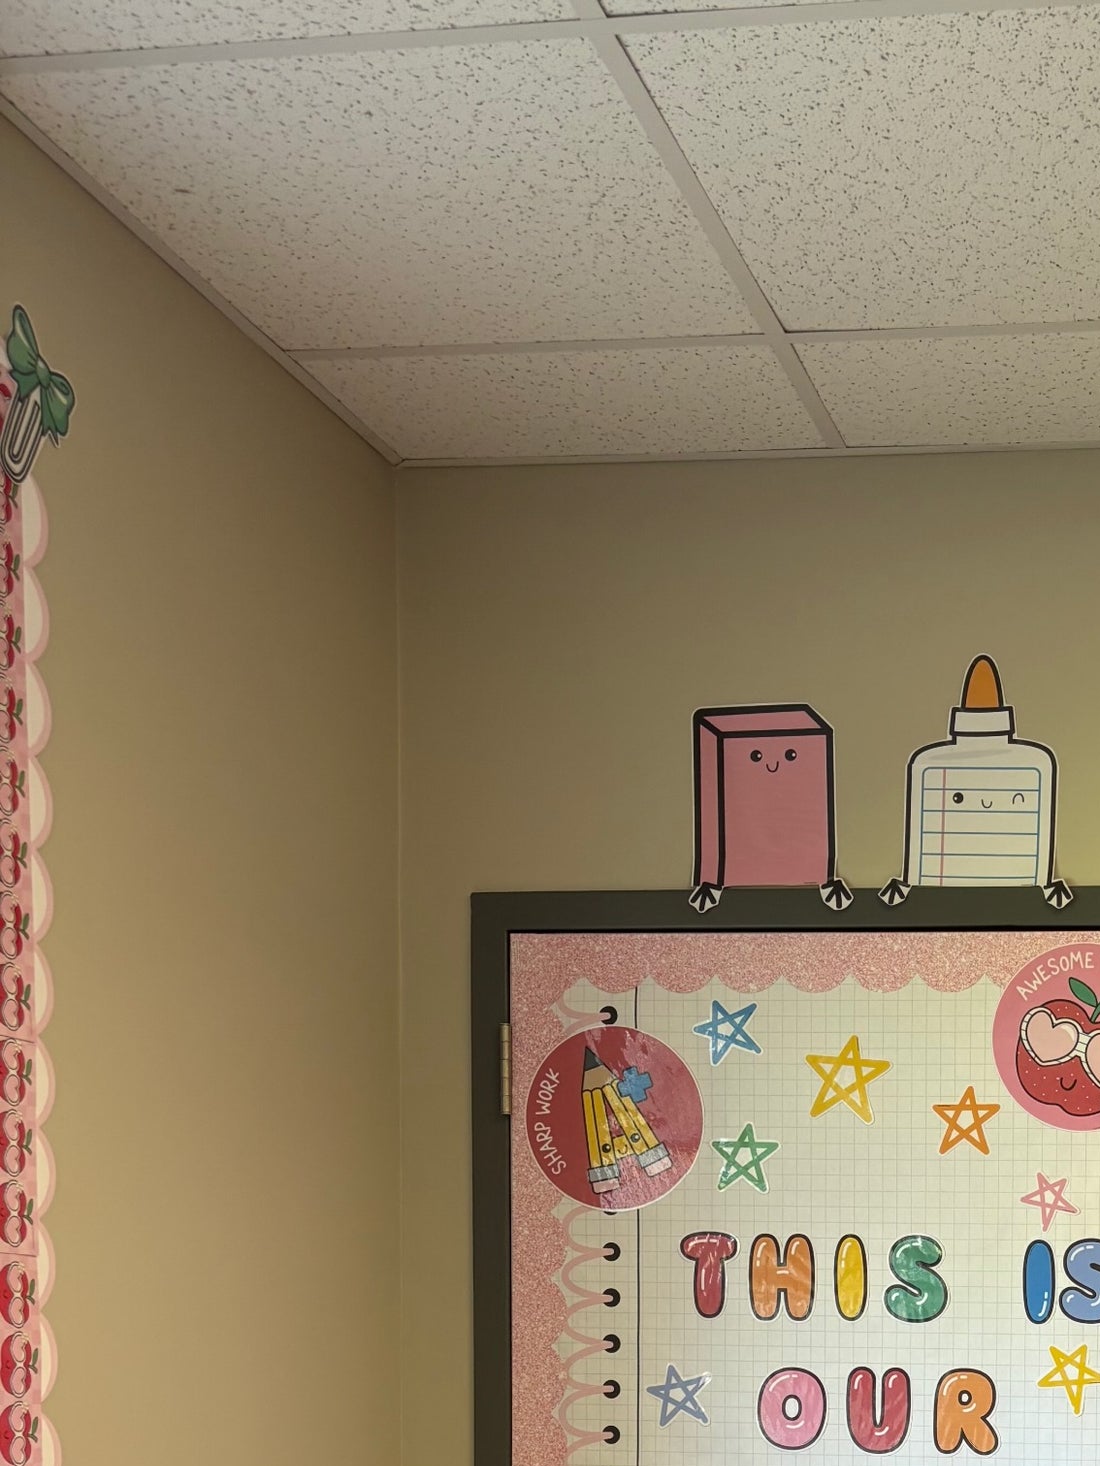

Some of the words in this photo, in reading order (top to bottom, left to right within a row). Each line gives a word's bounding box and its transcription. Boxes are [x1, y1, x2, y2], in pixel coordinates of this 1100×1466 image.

[1016, 951, 1095, 1000] AWESOME
[535, 1068, 560, 1115] WORK
[534, 1122, 567, 1175] SHARP
[680, 1232, 948, 1323] THIS
[757, 1367, 1000, 1455] OUR
